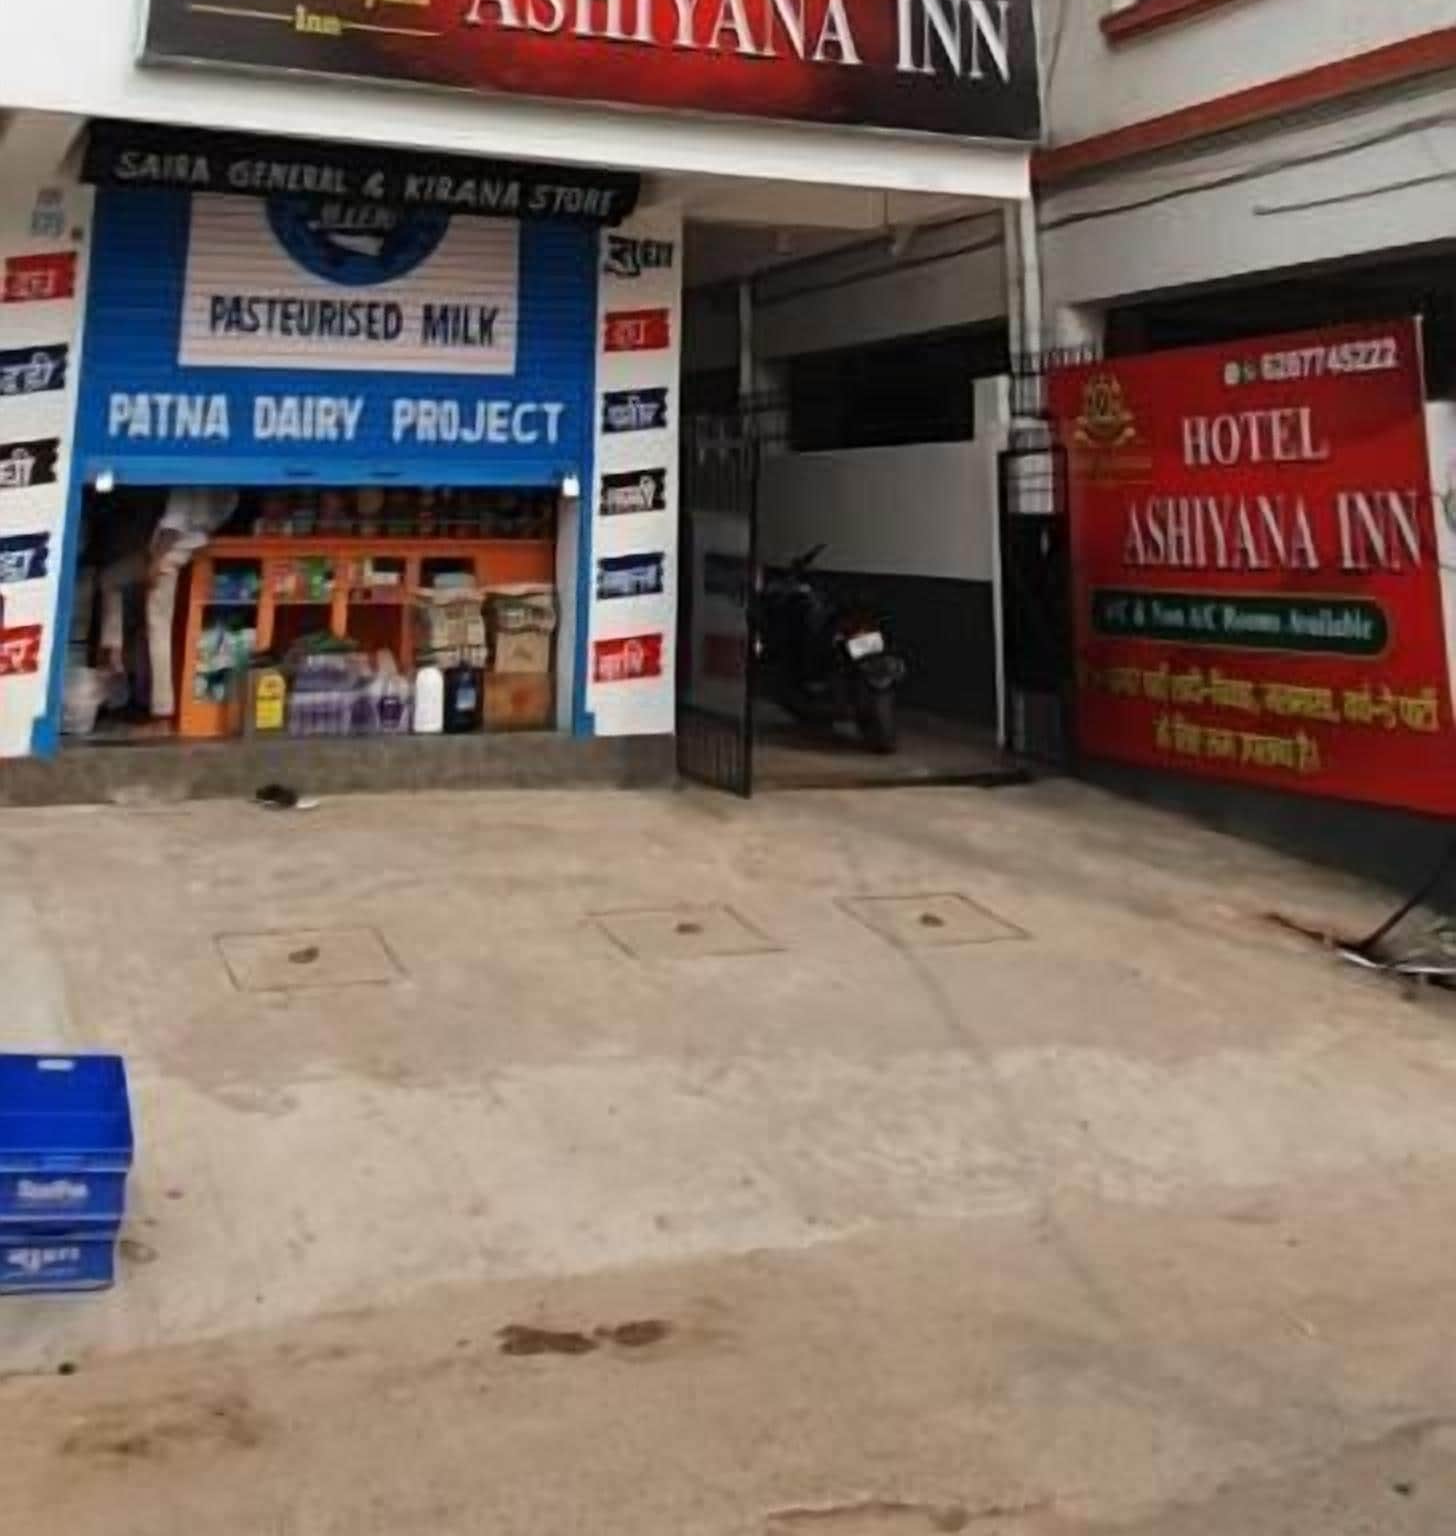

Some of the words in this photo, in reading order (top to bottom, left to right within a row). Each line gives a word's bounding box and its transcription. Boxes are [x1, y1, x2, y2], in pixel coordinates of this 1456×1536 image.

[295, 4, 343, 36] Inn
[227, 160, 348, 196] GENERAL
[404, 174, 520, 210] KIRANA
[529, 184, 622, 216] STORE
[208, 294, 403, 343] PASTEURISED
[420, 302, 498, 348] MILK
[108, 392, 230, 440] PATNA
[253, 395, 365, 441] DAIRY
[392, 399, 567, 444] PROJECT
[1182, 407, 1331, 465] HOTEL
[1124, 494, 1320, 569] ASHIYANA
[1337, 490, 1423, 571] INN
